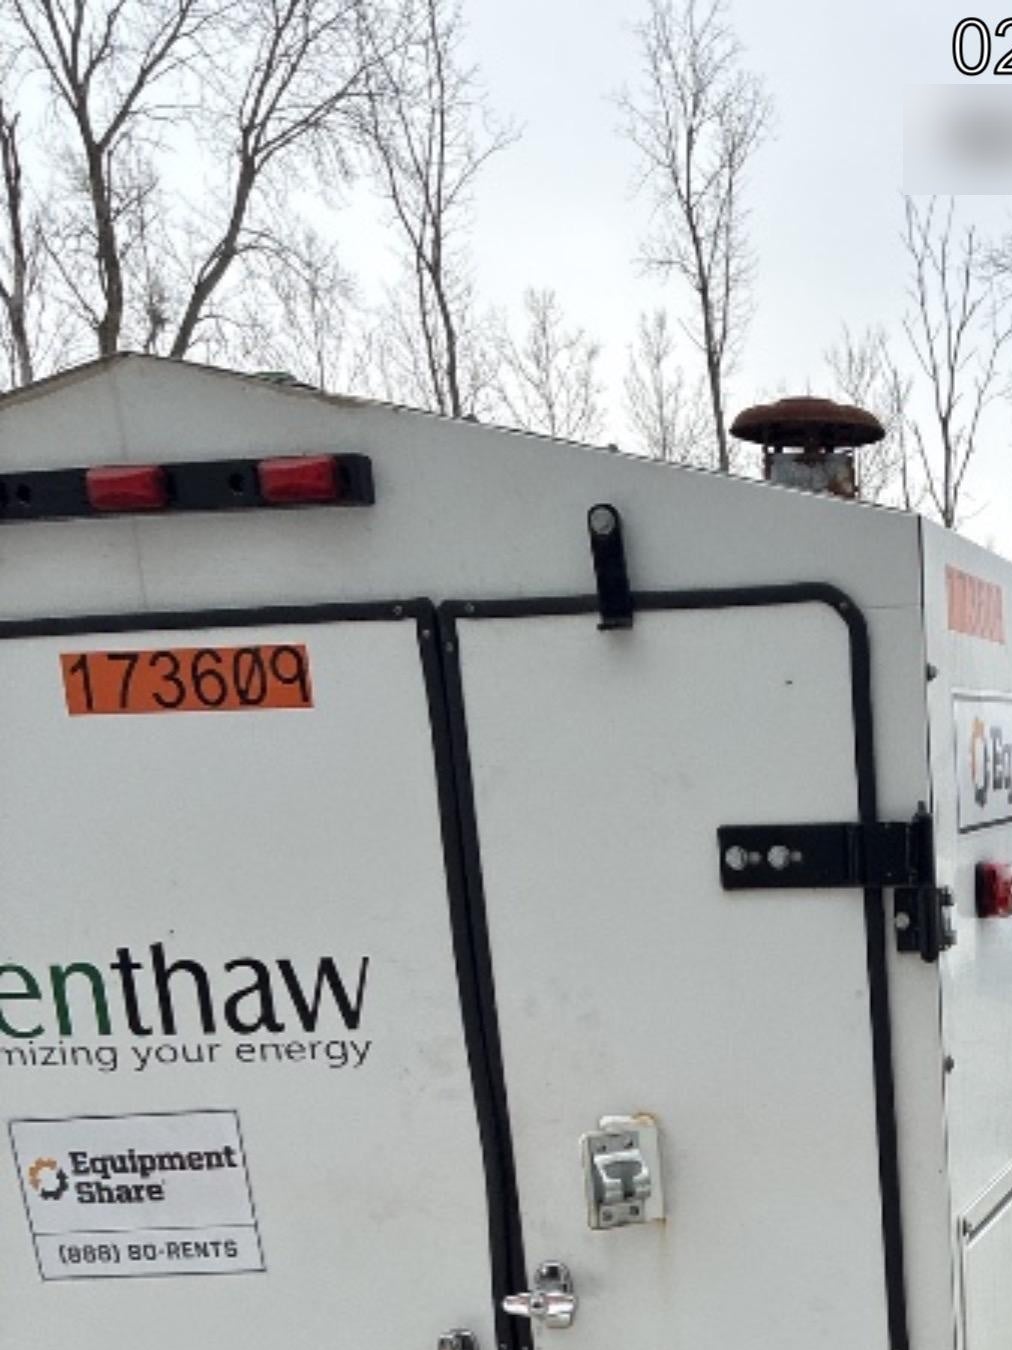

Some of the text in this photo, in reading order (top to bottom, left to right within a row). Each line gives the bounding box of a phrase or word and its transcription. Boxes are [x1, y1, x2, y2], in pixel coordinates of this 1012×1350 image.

[68, 645, 312, 712] 173609
[130, 1043, 221, 1072] your
[235, 1039, 371, 1068] energy
[68, 1145, 238, 1179] Equipment
[75, 1181, 165, 1204] Share
